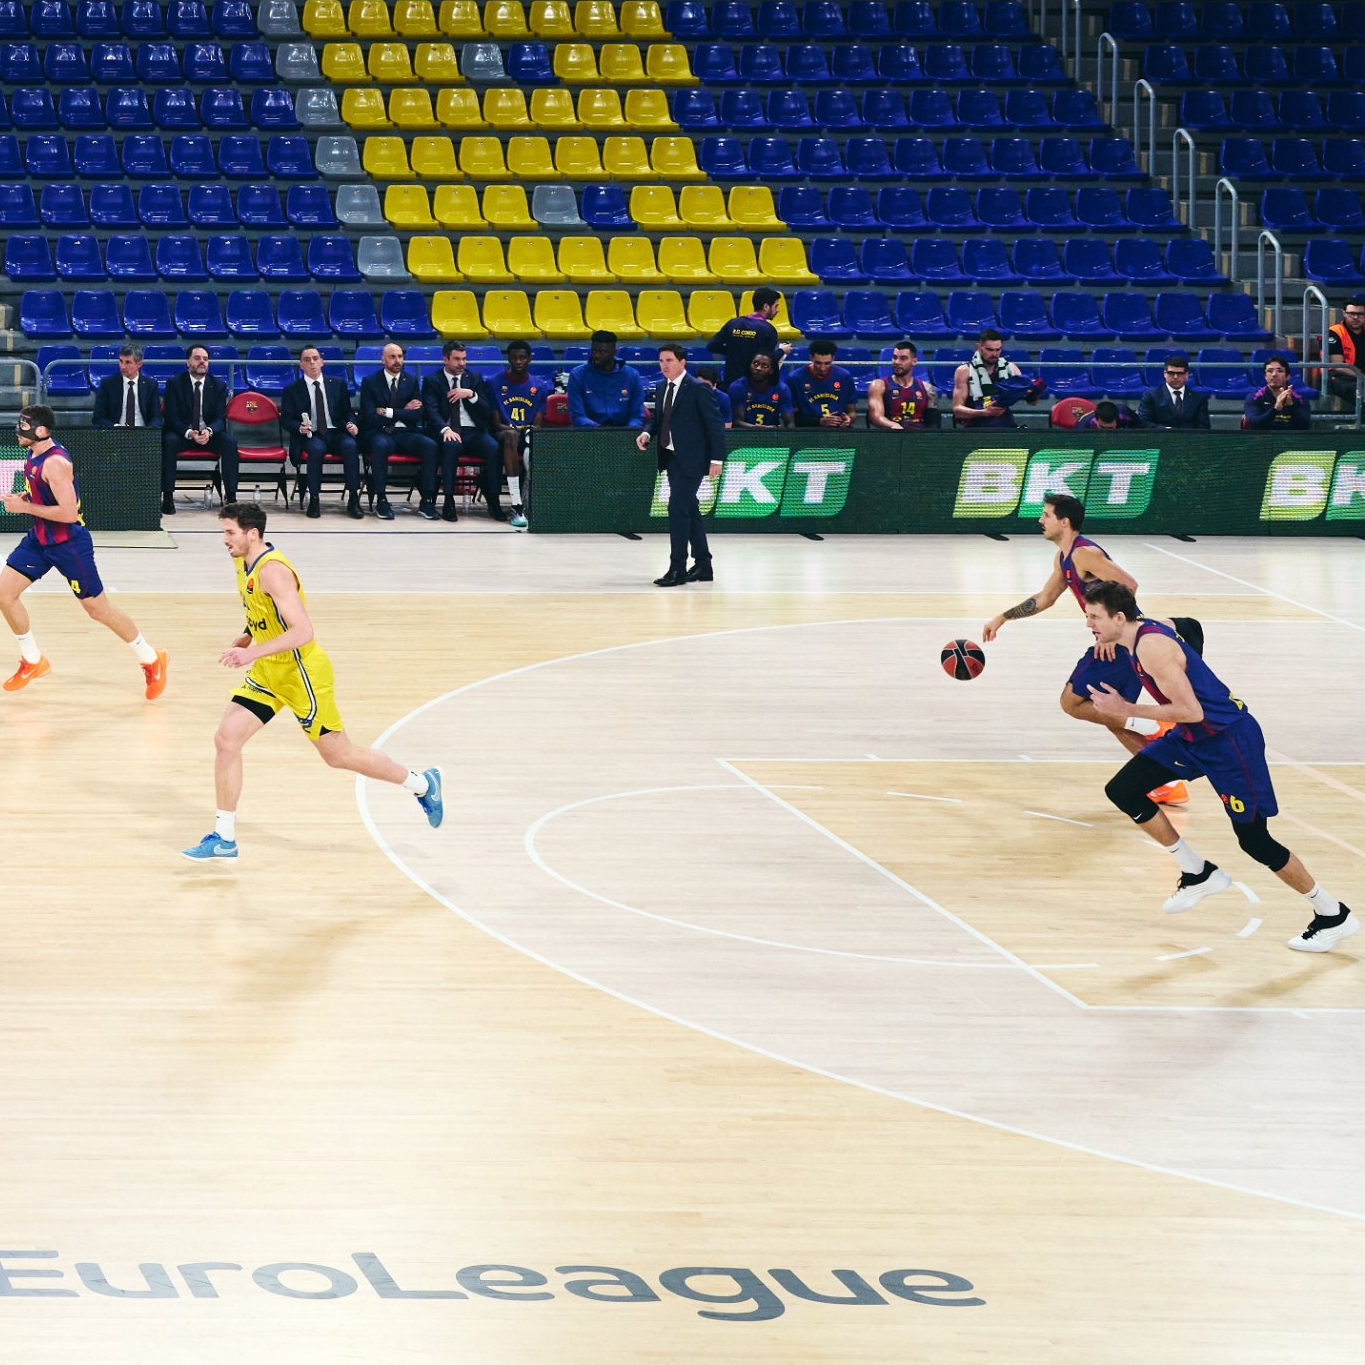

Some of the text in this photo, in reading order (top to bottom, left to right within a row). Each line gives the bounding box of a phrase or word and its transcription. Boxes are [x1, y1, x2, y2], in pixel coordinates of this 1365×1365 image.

[511, 408, 525, 421] 41
[901, 402, 916, 414] 14
[962, 463, 1149, 504] BKT
[1230, 795, 1245, 813] 6
